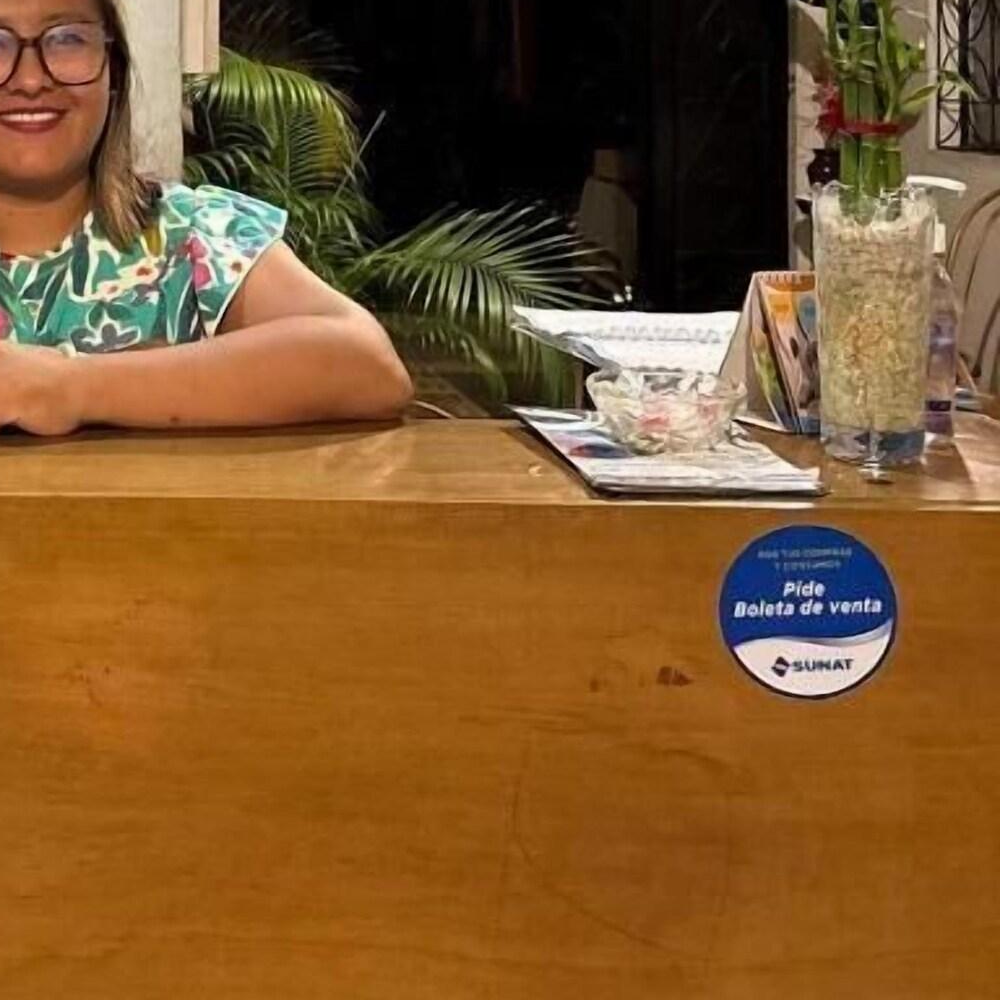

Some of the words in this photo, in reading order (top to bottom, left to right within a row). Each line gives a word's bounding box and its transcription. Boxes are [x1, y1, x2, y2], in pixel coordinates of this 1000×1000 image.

[783, 580, 826, 597] Pide
[734, 600, 795, 618] Boleta
[800, 598, 823, 616] de
[830, 597, 883, 615] venta
[792, 658, 855, 673] SUNAT
